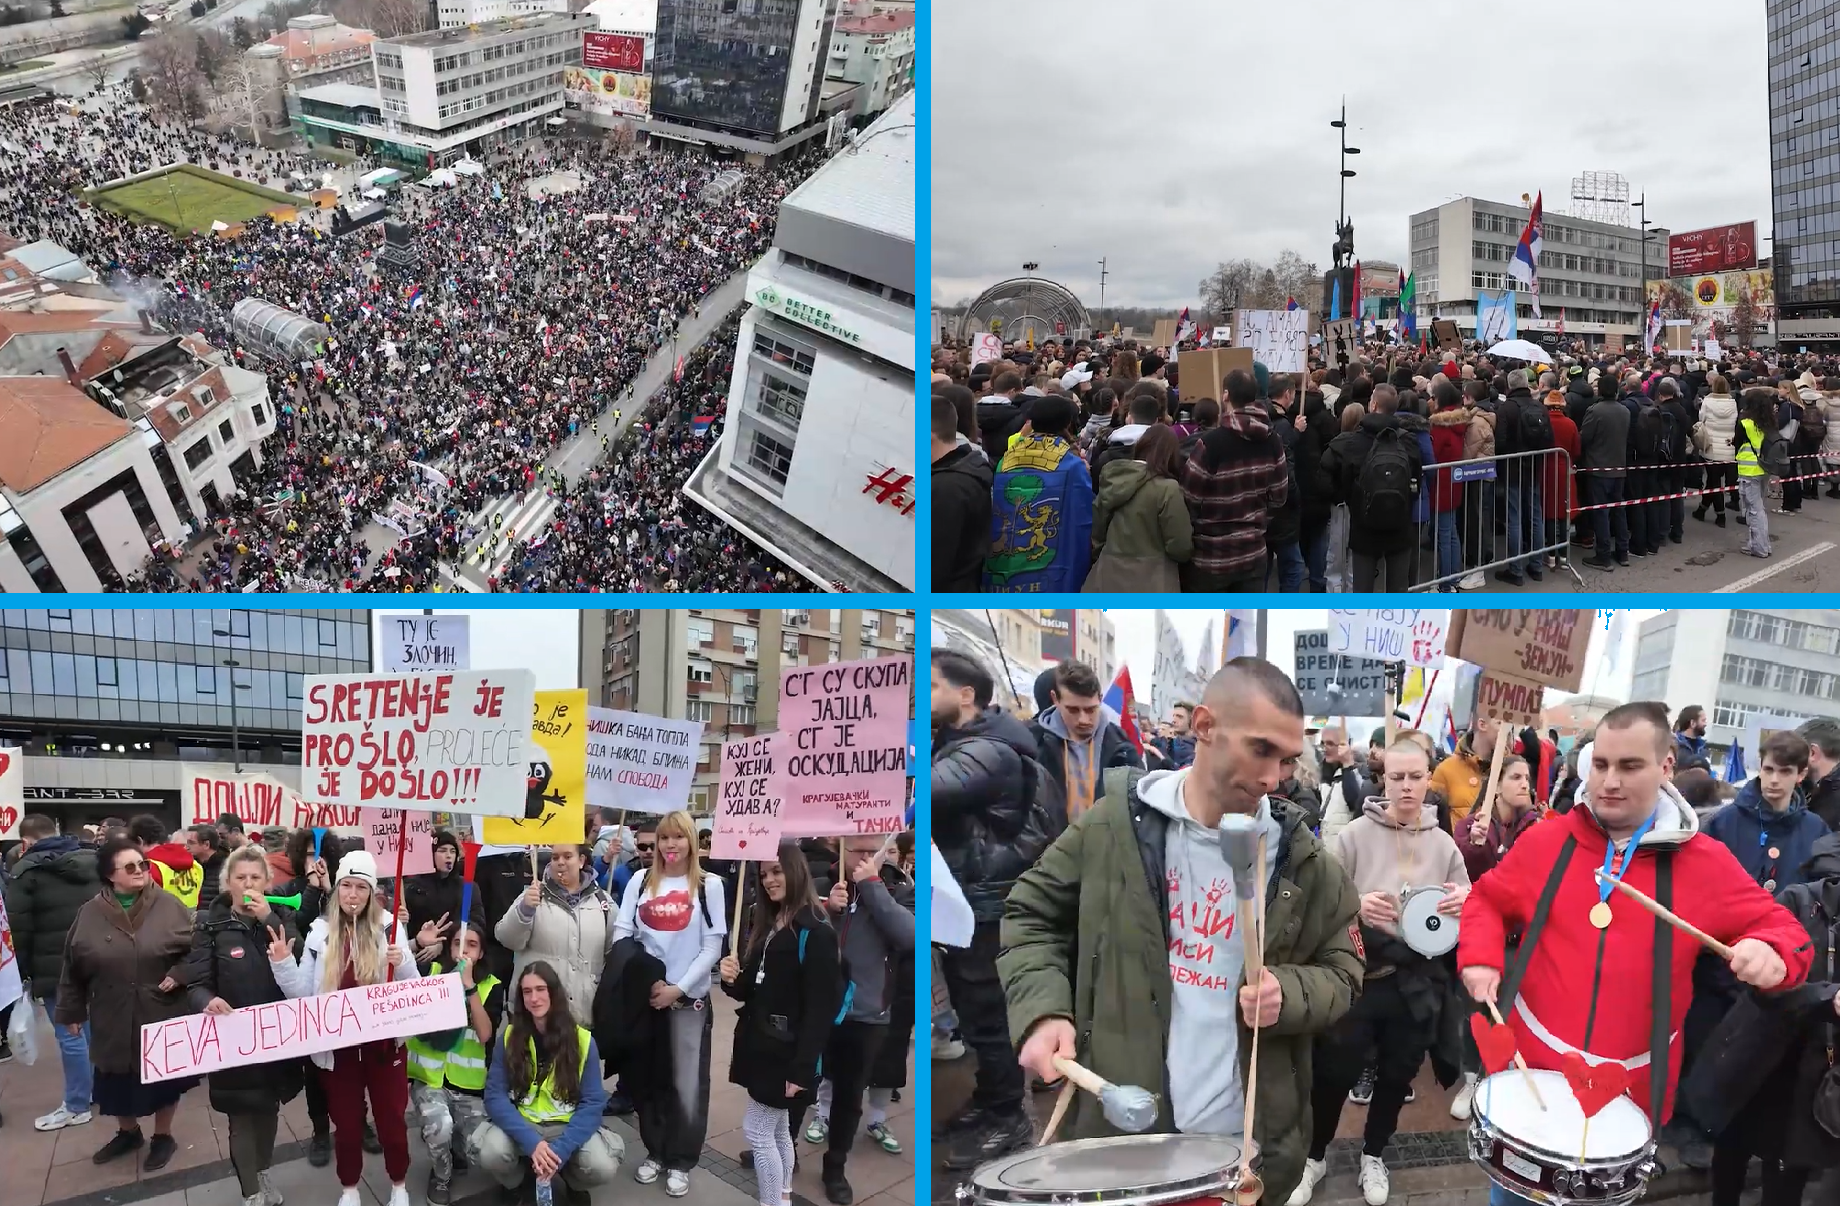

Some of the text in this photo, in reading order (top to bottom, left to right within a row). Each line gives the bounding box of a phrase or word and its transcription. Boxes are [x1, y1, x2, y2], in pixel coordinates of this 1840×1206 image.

[1682, 233, 1703, 242] VICHY
[762, 293, 775, 303] BC
[787, 298, 831, 321] BETTER
[785, 307, 860, 342] COLLECTIVE
[862, 467, 915, 515] H&
[397, 619, 439, 642] ТУ ЈЕ
[1338, 622, 1404, 656] У НИШ
[402, 644, 457, 666] ЗЛОЧИН,
[1296, 655, 1352, 671] ВРЕМЕ
[823, 668, 847, 694] СУ
[853, 661, 907, 689] СКУПА
[1297, 677, 1316, 691] СЕ
[473, 678, 505, 718] JE
[1478, 677, 1544, 714] ПУМПАЈ
[811, 694, 877, 722] ЈАЈЦА,
[306, 722, 522, 771] PROŠLO, PROLEĆE
[626, 724, 653, 741] БАЊА
[656, 728, 689, 747] ТОПЛА
[834, 724, 856, 748] ЈЕ
[727, 738, 771, 760] КУЈ СЕ
[734, 757, 776, 777] ЖЕНИ,
[788, 747, 906, 777] ОСКУДАЦИЈА
[318, 763, 482, 806] JE DOŠLO!!!
[586, 763, 668, 790] НАМ СЛОБОДА
[724, 778, 768, 798] КУЈ СЕ
[193, 777, 283, 826] ДОШЛИ
[802, 789, 869, 804] КРАГУЈЕВАЧКИ
[836, 799, 891, 810] МАТУРАНТИ
[846, 810, 854, 820] И
[853, 815, 902, 833] ТАЧКА
[372, 823, 400, 837] дана
[377, 840, 385, 855] у
[143, 1015, 222, 1080] KEVA
